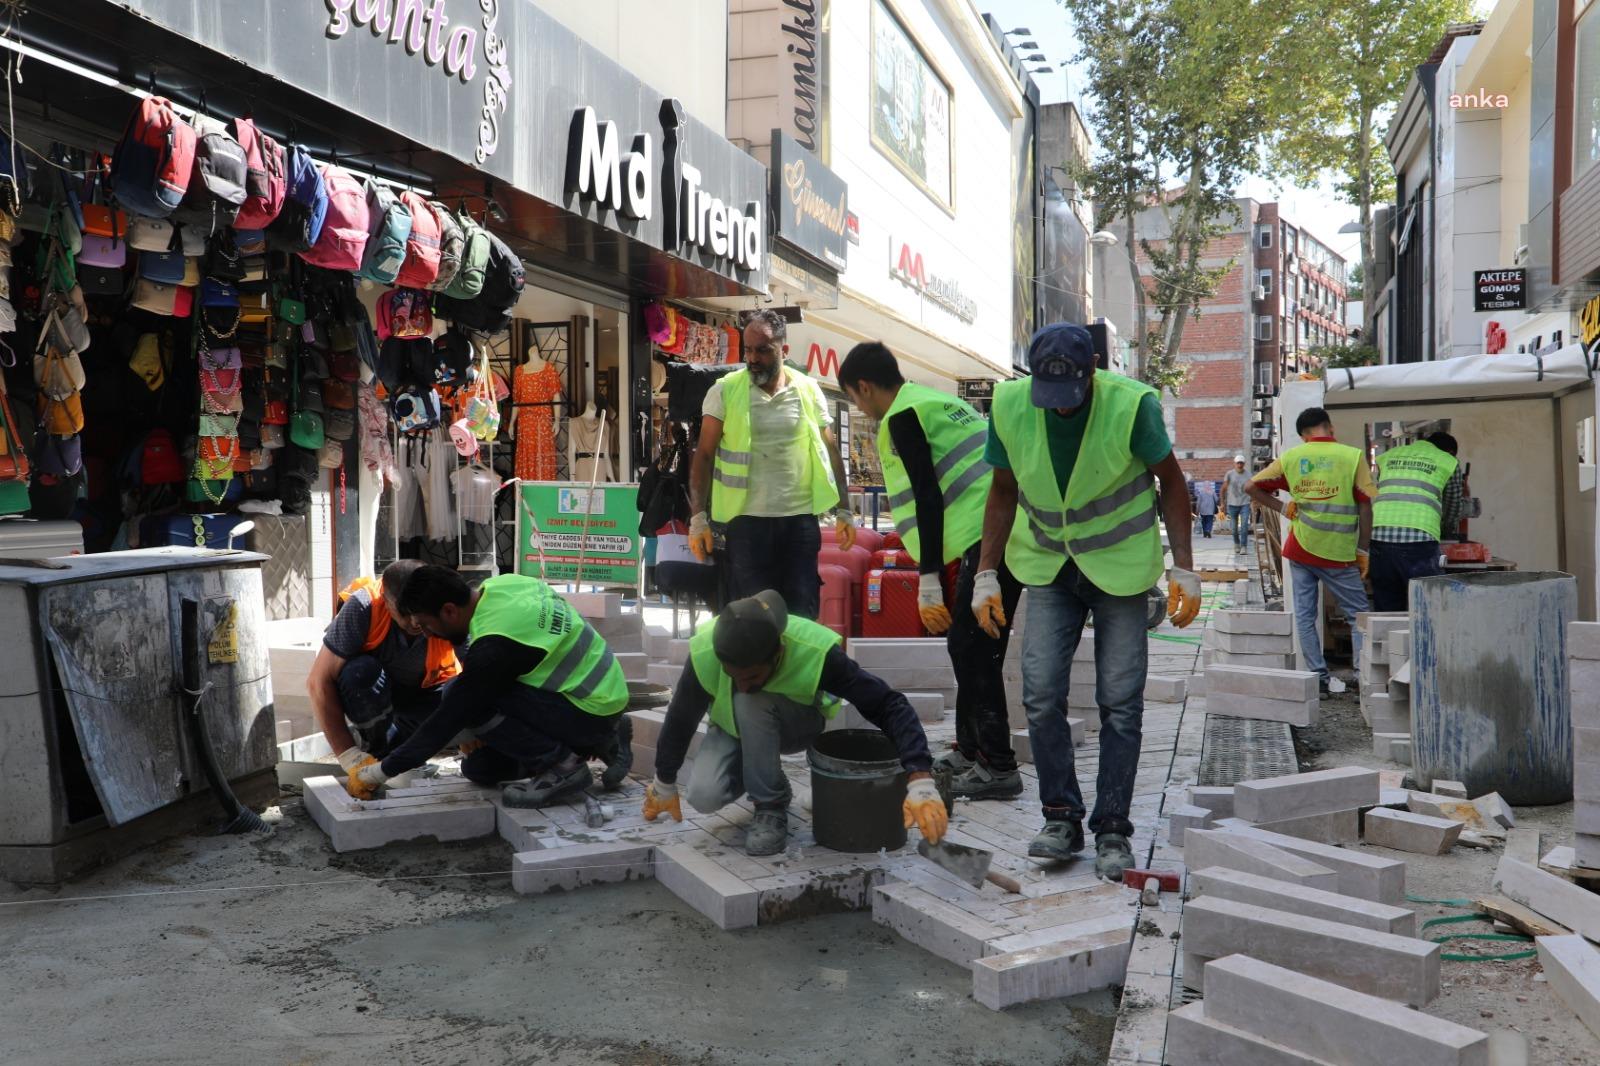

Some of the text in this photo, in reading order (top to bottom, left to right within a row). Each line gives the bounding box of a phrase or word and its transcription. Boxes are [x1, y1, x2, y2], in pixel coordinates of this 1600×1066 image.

[570, 105, 761, 271] Md Trend
[1479, 271, 1522, 282] AKTEPE
